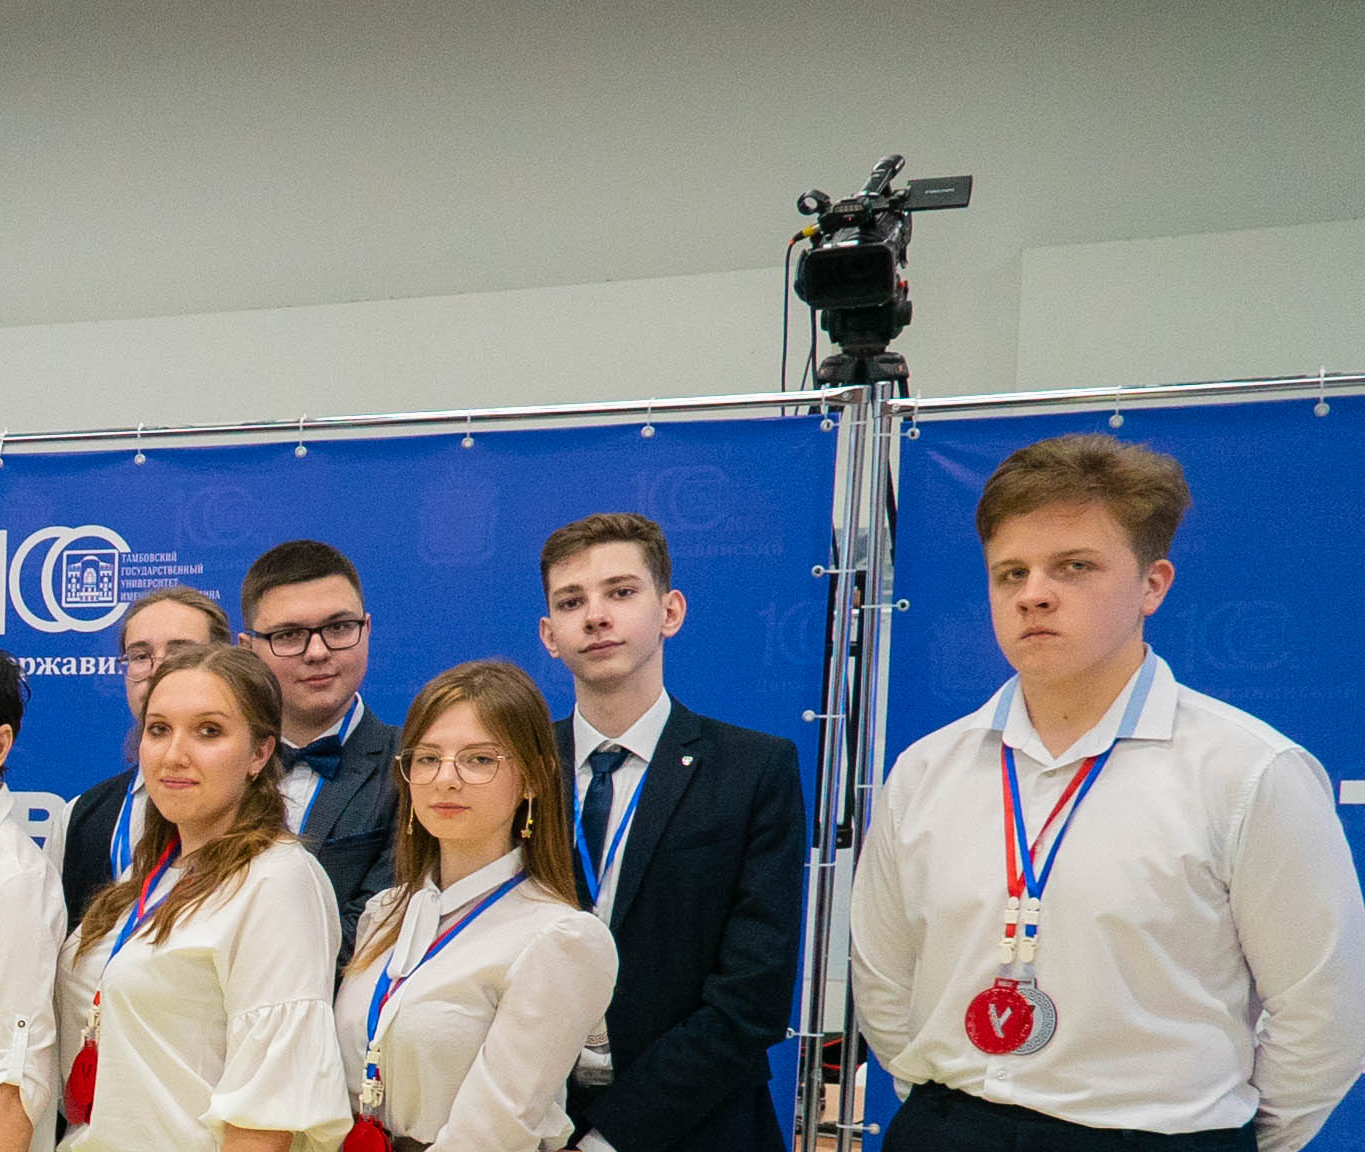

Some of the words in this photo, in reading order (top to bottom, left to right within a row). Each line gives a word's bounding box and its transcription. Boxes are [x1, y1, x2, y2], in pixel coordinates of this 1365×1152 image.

[121, 551, 177, 563] ТАМБОВСКИЙ
[120, 563, 204, 576] ГОСУДАРСТВЕННЫЙ
[120, 578, 179, 589] УНИВЕРСИТЕТ
[11, 656, 124, 676] ржави
